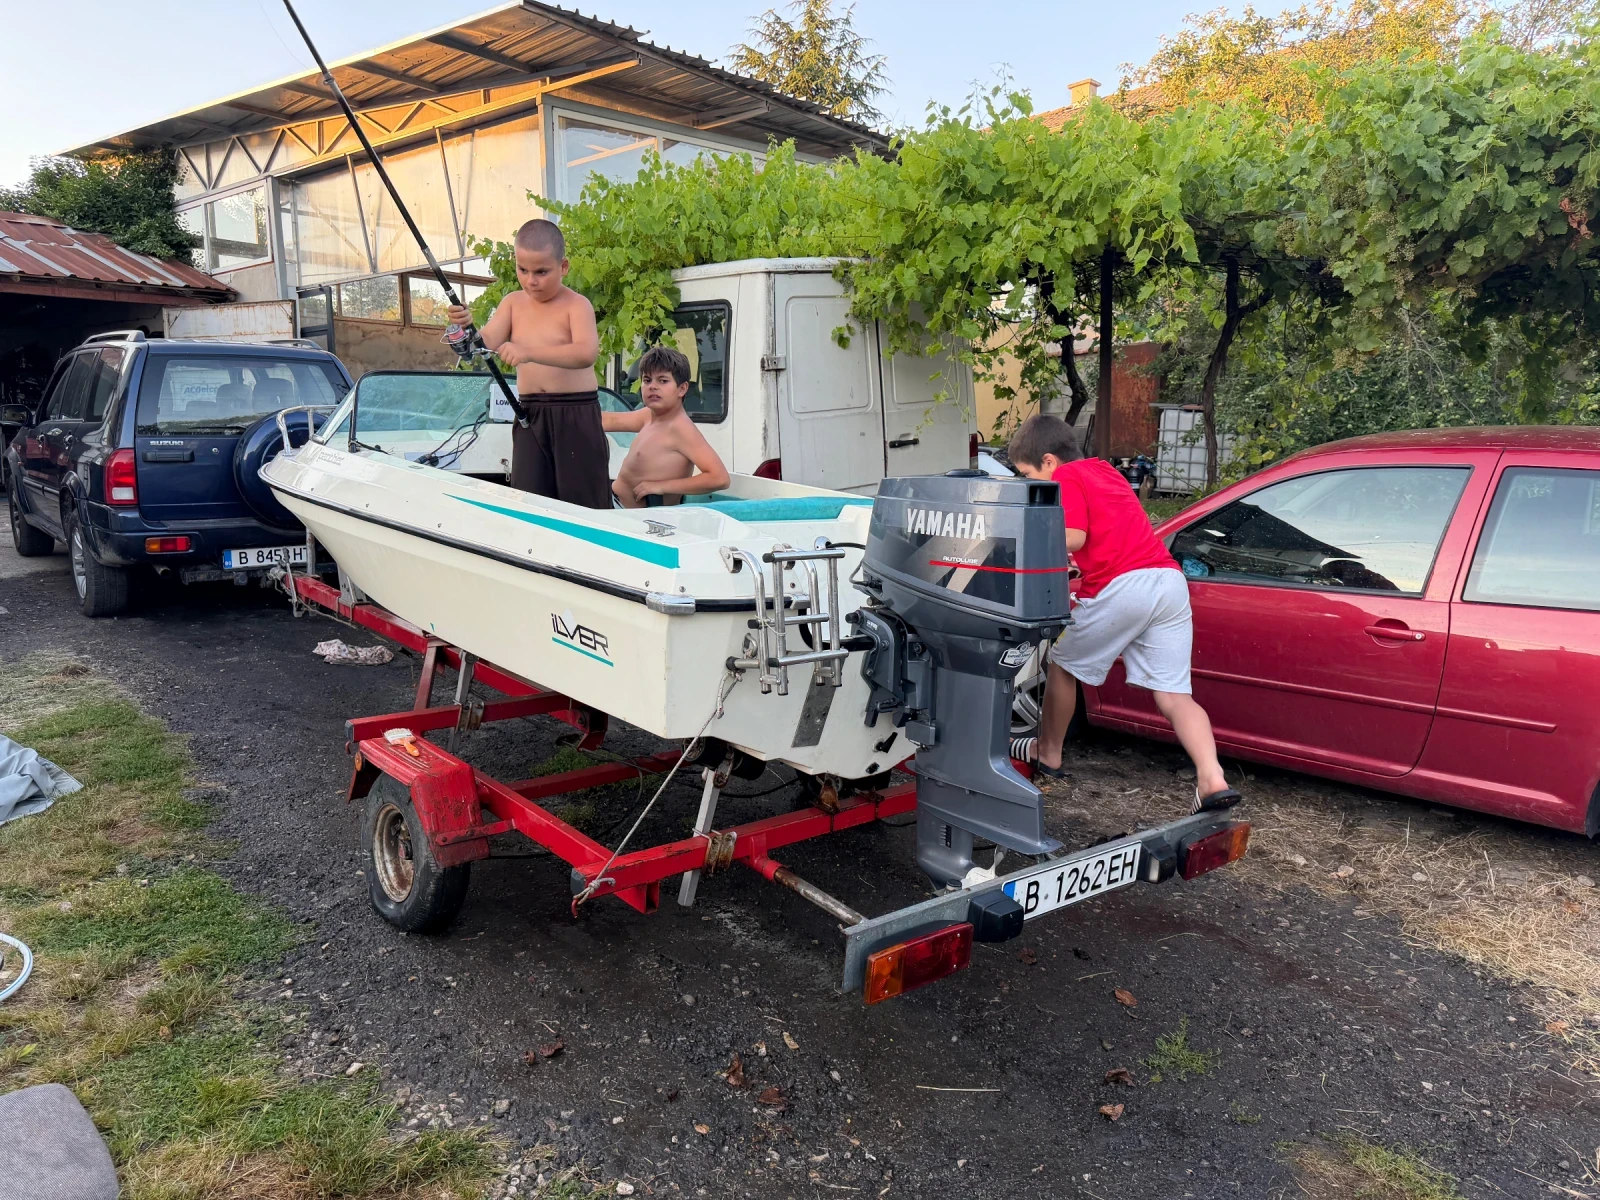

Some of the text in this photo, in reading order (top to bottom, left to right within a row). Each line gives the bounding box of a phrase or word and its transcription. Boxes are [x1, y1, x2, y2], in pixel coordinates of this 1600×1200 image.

[907, 507, 986, 541] YAMAHA
[238, 551, 249, 565] B
[942, 555, 979, 565] AUTOLUBE
[1024, 848, 1137, 915] B 1262 EH
